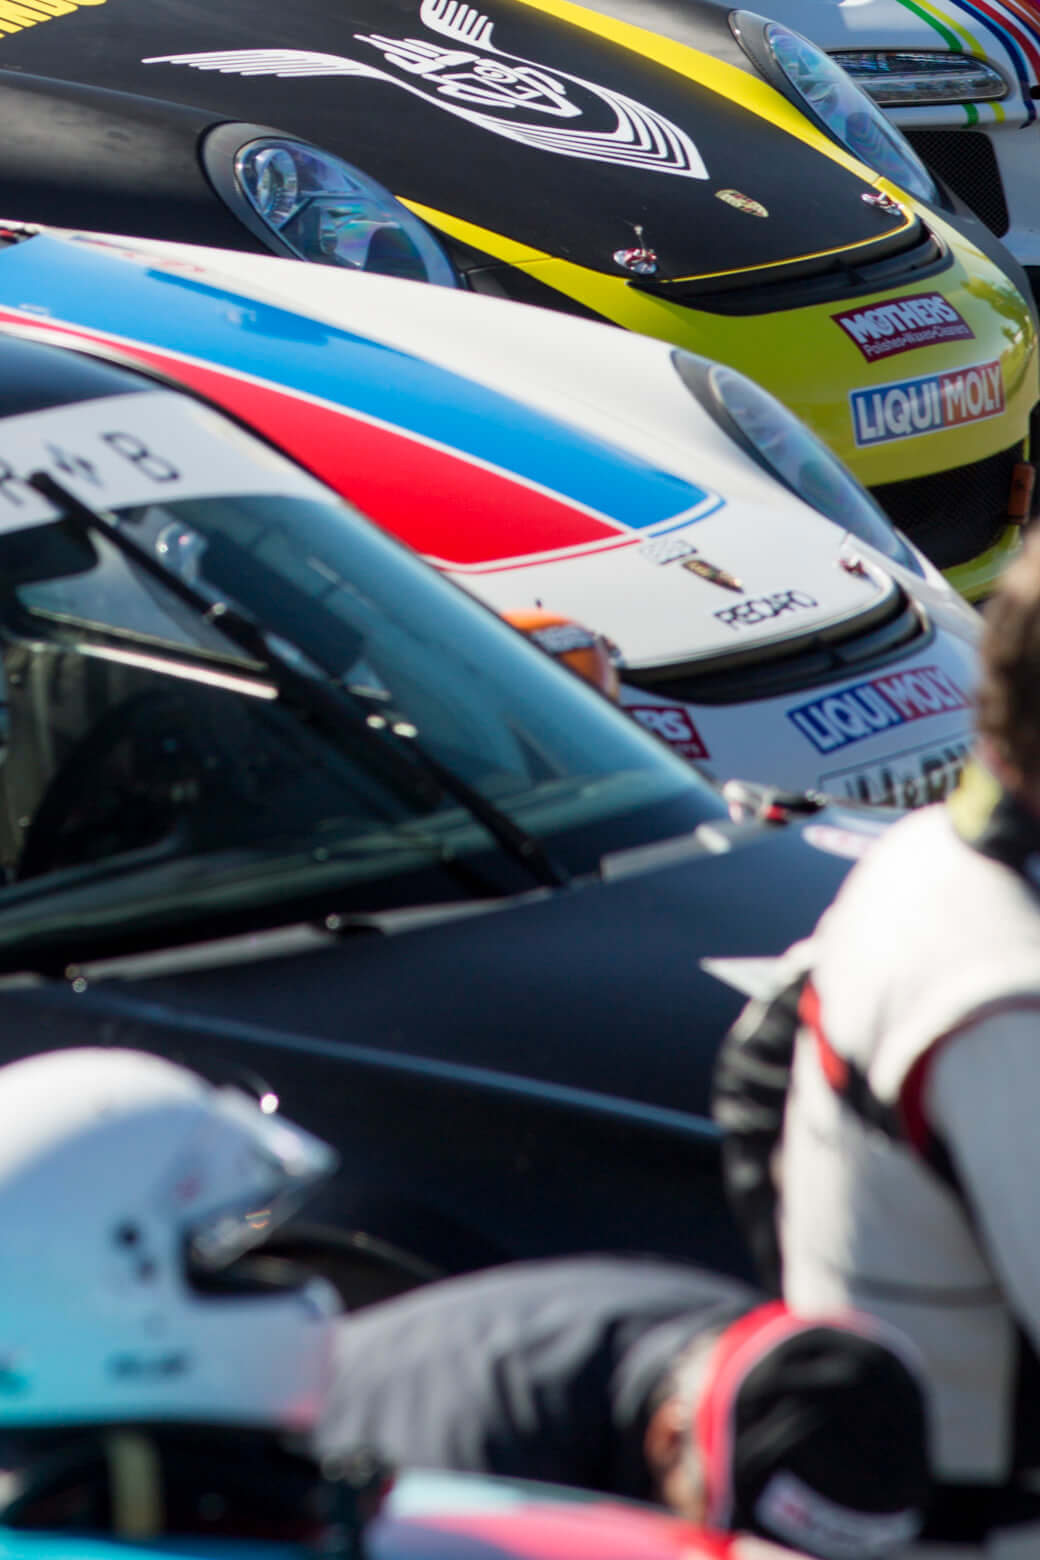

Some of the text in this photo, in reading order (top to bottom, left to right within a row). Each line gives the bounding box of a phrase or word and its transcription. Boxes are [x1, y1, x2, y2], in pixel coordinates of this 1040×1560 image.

[840, 296, 959, 343] MOTHERS
[856, 365, 1000, 440] LIQUI MOLY
[103, 431, 181, 483] B
[713, 590, 819, 631] RECARO
[794, 670, 964, 749] LIQUI MOLY
